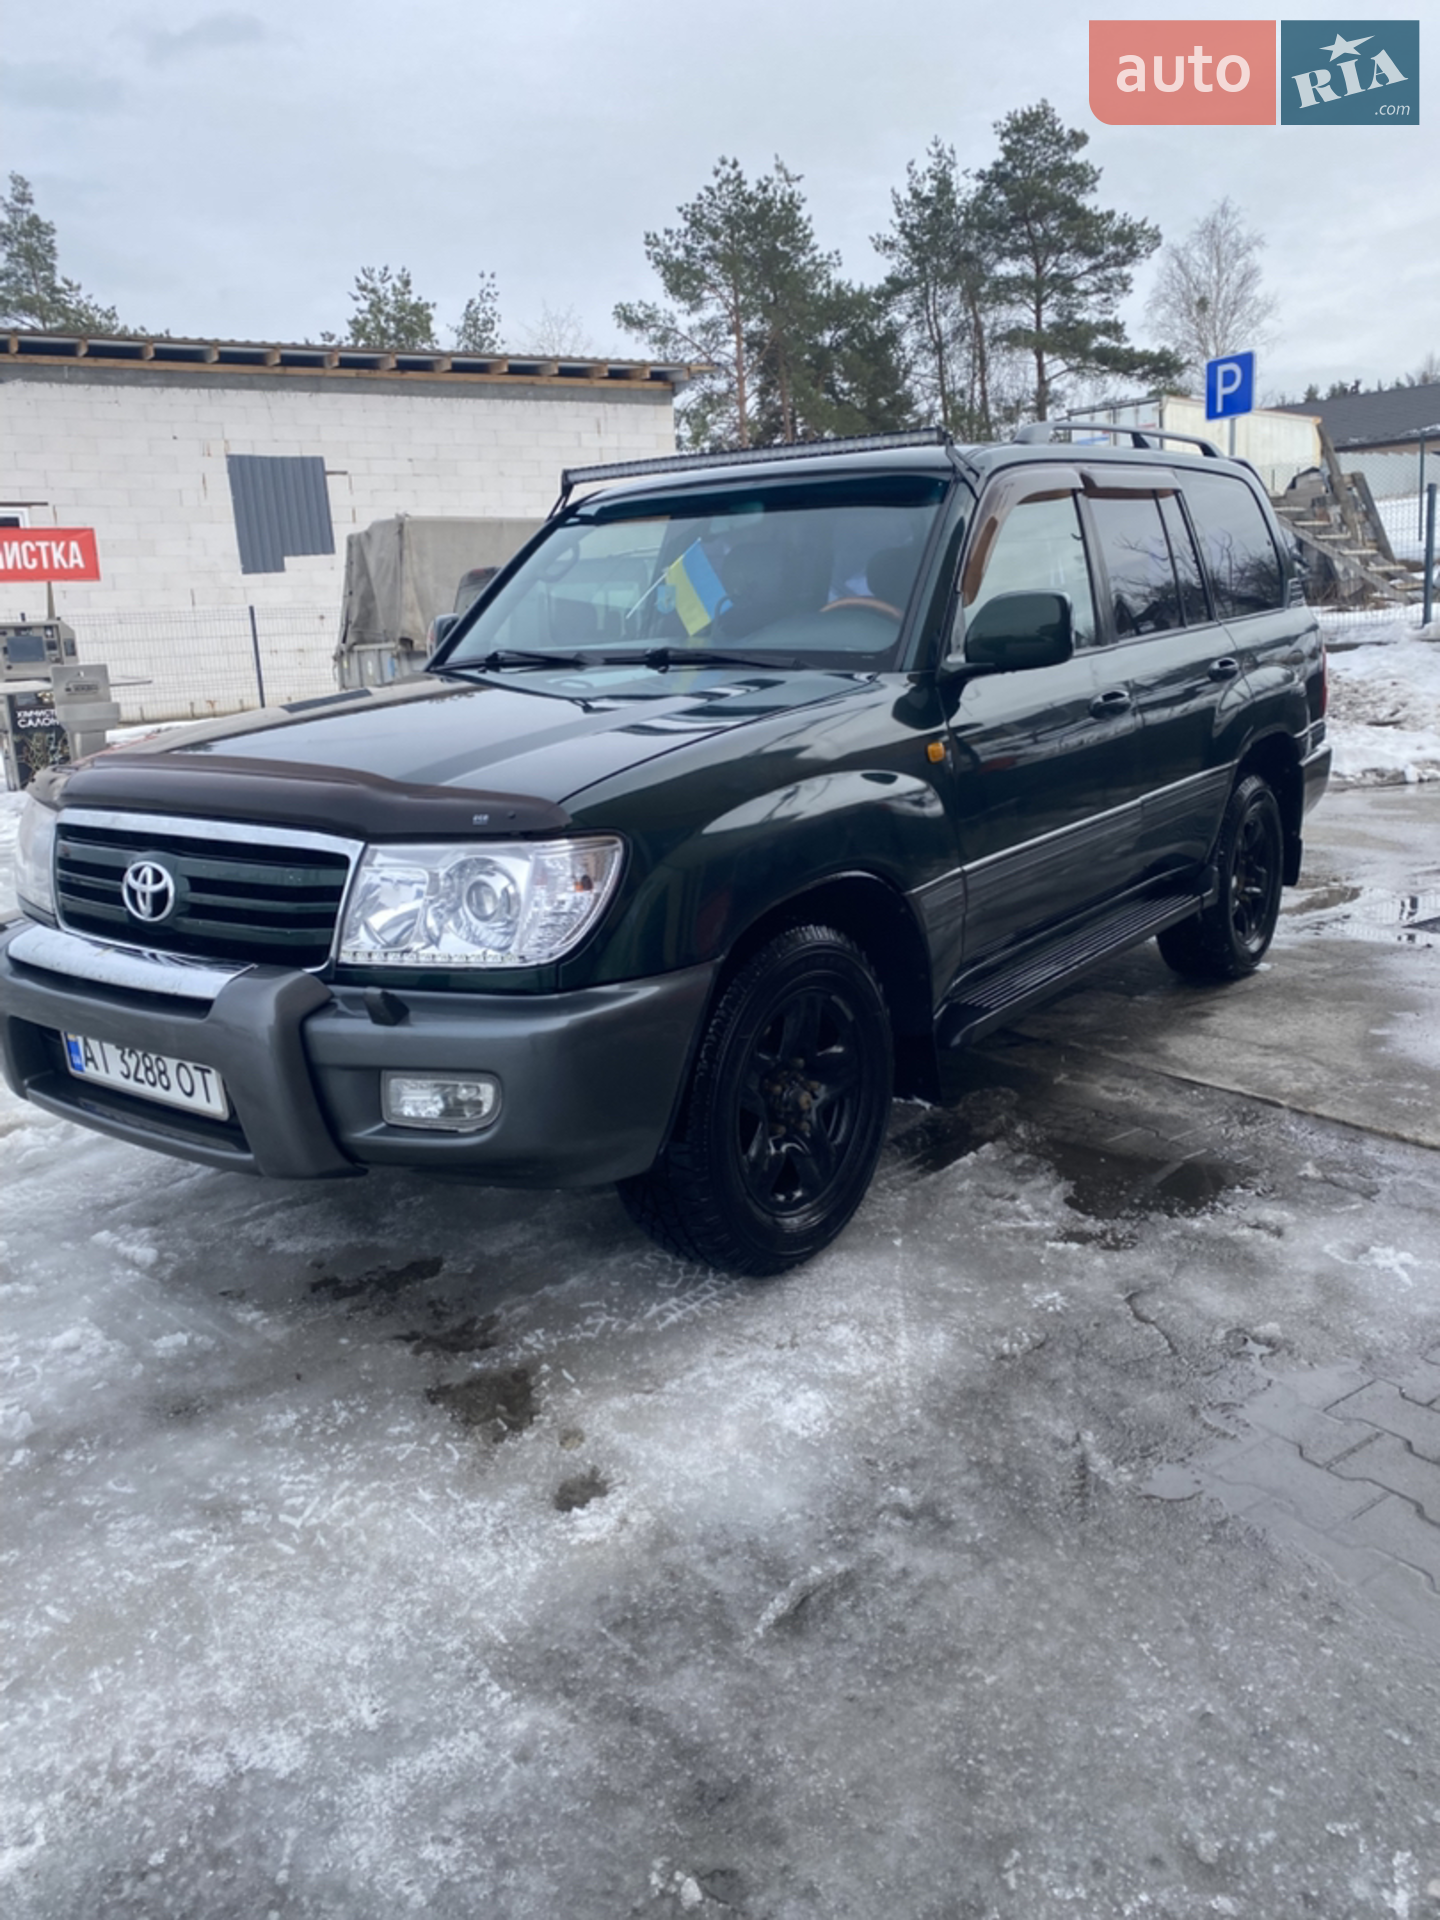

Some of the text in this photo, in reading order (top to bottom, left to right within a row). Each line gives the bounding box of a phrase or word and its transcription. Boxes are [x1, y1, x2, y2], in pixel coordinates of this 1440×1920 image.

[1216, 362, 1242, 413] P
[0, 540, 85, 570] ИСТКА
[115, 1045, 171, 1092] 3288
[176, 1062, 212, 1104] OT
